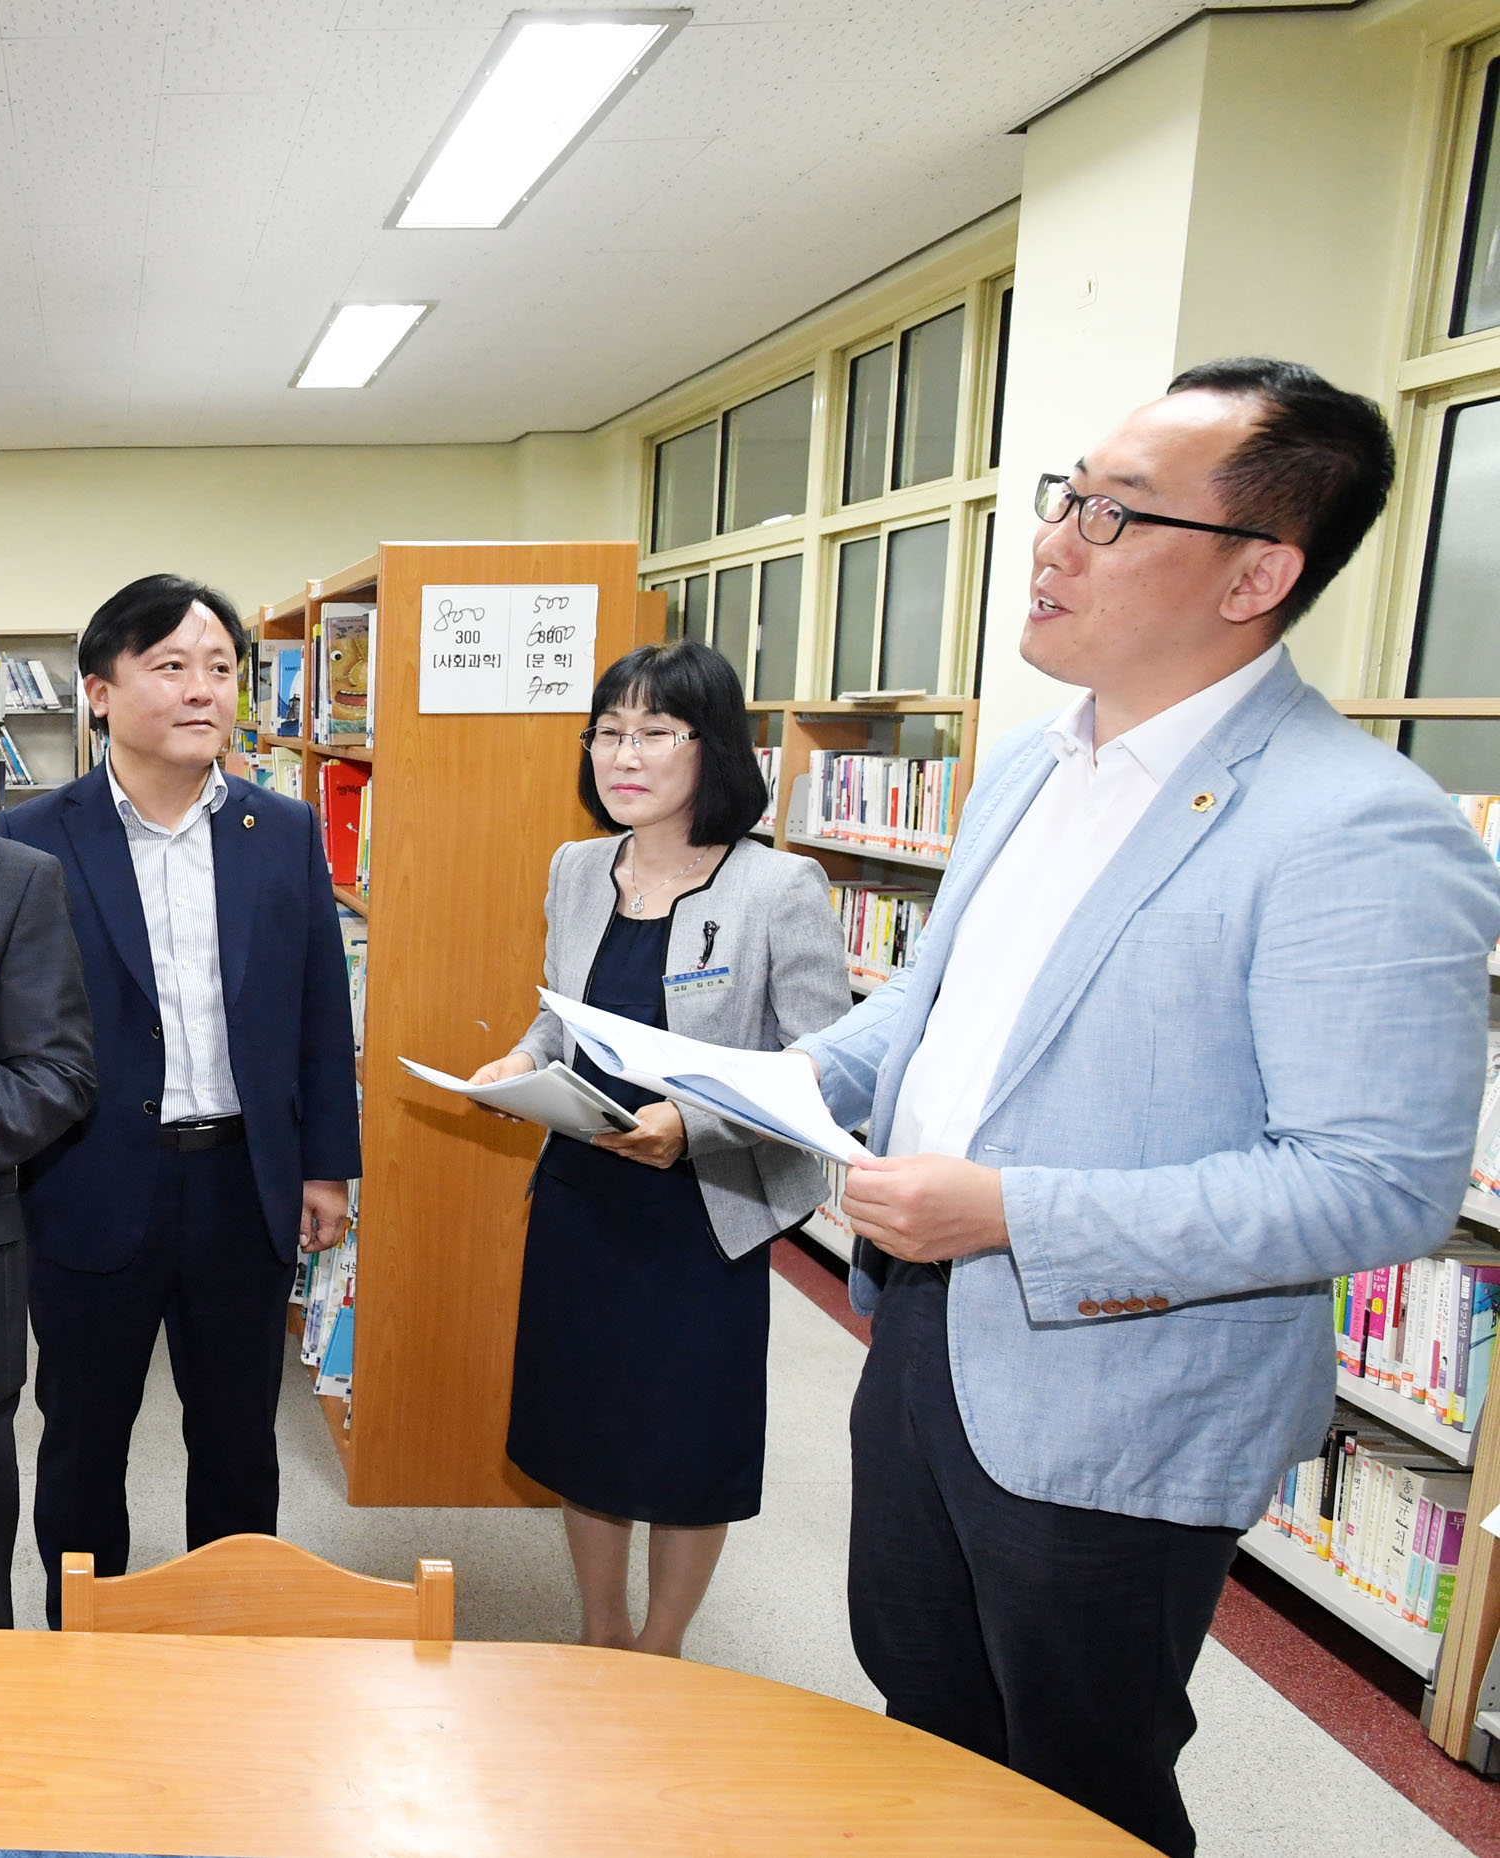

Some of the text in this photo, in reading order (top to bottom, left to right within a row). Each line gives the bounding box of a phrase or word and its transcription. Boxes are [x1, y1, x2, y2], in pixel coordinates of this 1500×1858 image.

[533, 595, 569, 613] 500
[433, 599, 486, 632] 800
[455, 630, 481, 644] 300
[433, 653, 502, 669] [사회과학]
[1460, 1274, 1472, 1300] ADHD
